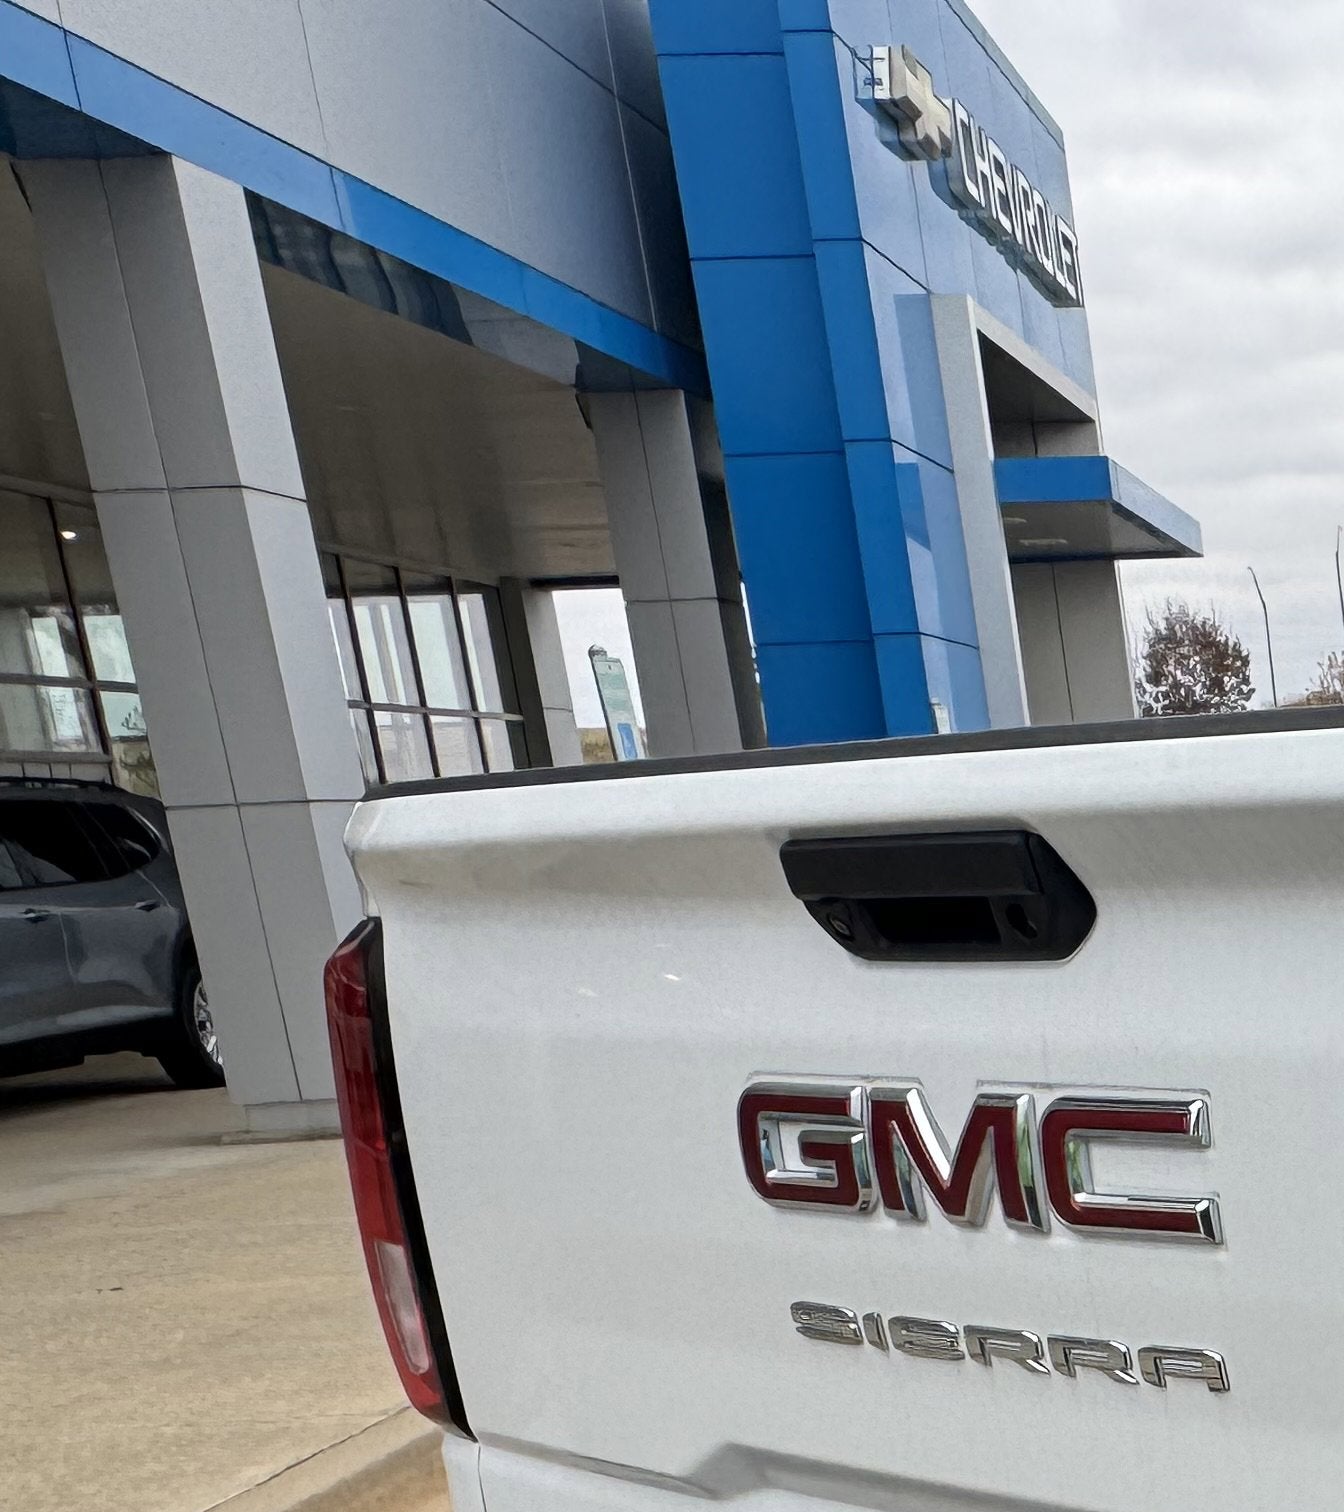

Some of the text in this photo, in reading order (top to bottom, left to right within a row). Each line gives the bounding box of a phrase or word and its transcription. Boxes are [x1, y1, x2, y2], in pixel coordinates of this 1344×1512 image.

[952, 98, 1084, 308] CHEVROLET
[737, 1076, 1224, 1246] GMC
[790, 1300, 1230, 1393] SIERRA
